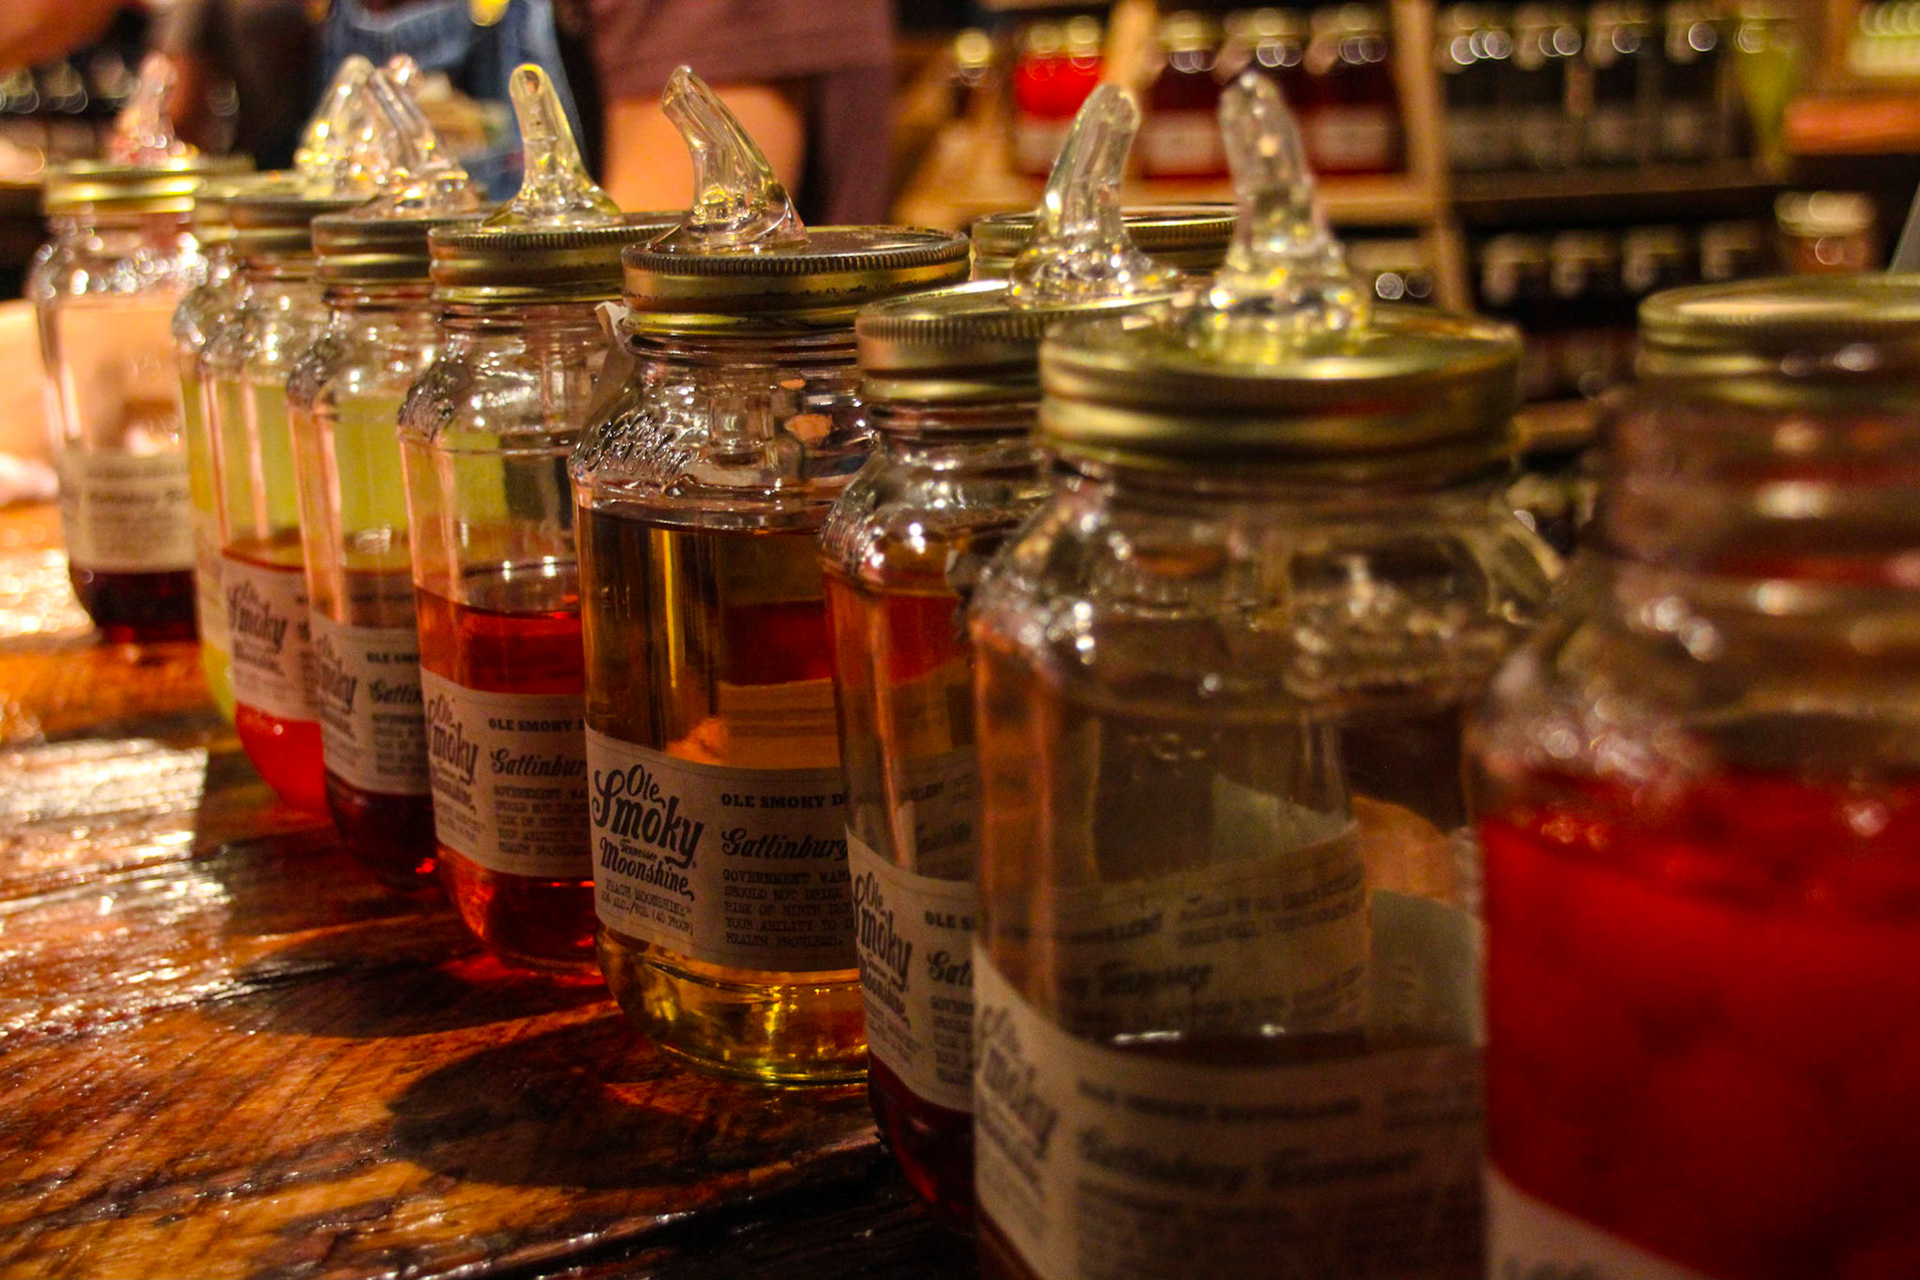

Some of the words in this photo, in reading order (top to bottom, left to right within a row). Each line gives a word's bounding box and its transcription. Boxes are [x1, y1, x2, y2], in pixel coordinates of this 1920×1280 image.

[489, 718, 514, 731] OLE
[518, 719, 572, 732] SMOKY
[627, 764, 666, 809] Ole
[721, 793, 755, 808] OLE
[760, 794, 825, 809] SMOKY
[592, 769, 705, 869] Smoky
[600, 836, 695, 901] Moonshine
[722, 868, 810, 885] GOVERNMENT
[925, 910, 955, 928] OLE
